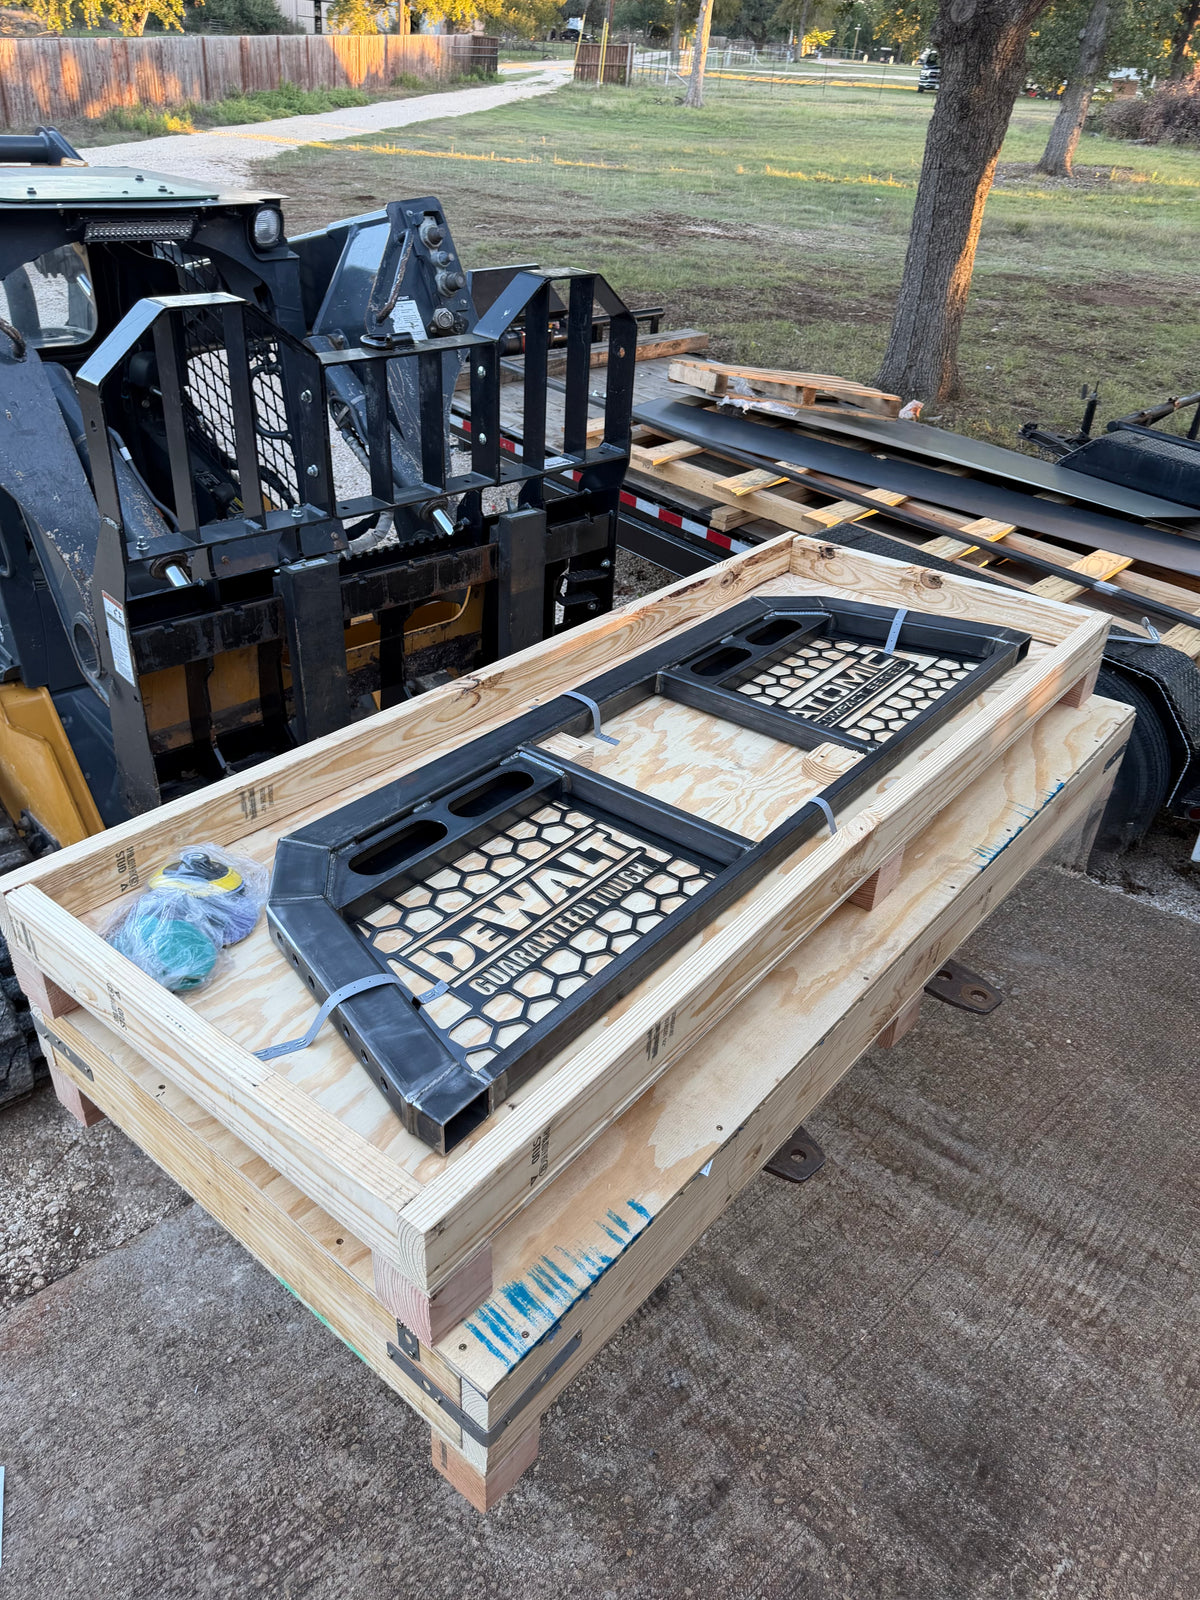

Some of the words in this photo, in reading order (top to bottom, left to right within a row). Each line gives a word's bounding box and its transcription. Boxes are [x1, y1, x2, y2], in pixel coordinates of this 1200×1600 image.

[787, 651, 896, 720] ATOMIC
[866, 663, 906, 691] SERIES
[115, 850, 127, 874] STUD
[407, 831, 629, 983] DEWALT
[468, 903, 600, 996] GUARANTEED
[531, 1136, 541, 1165] STUD
